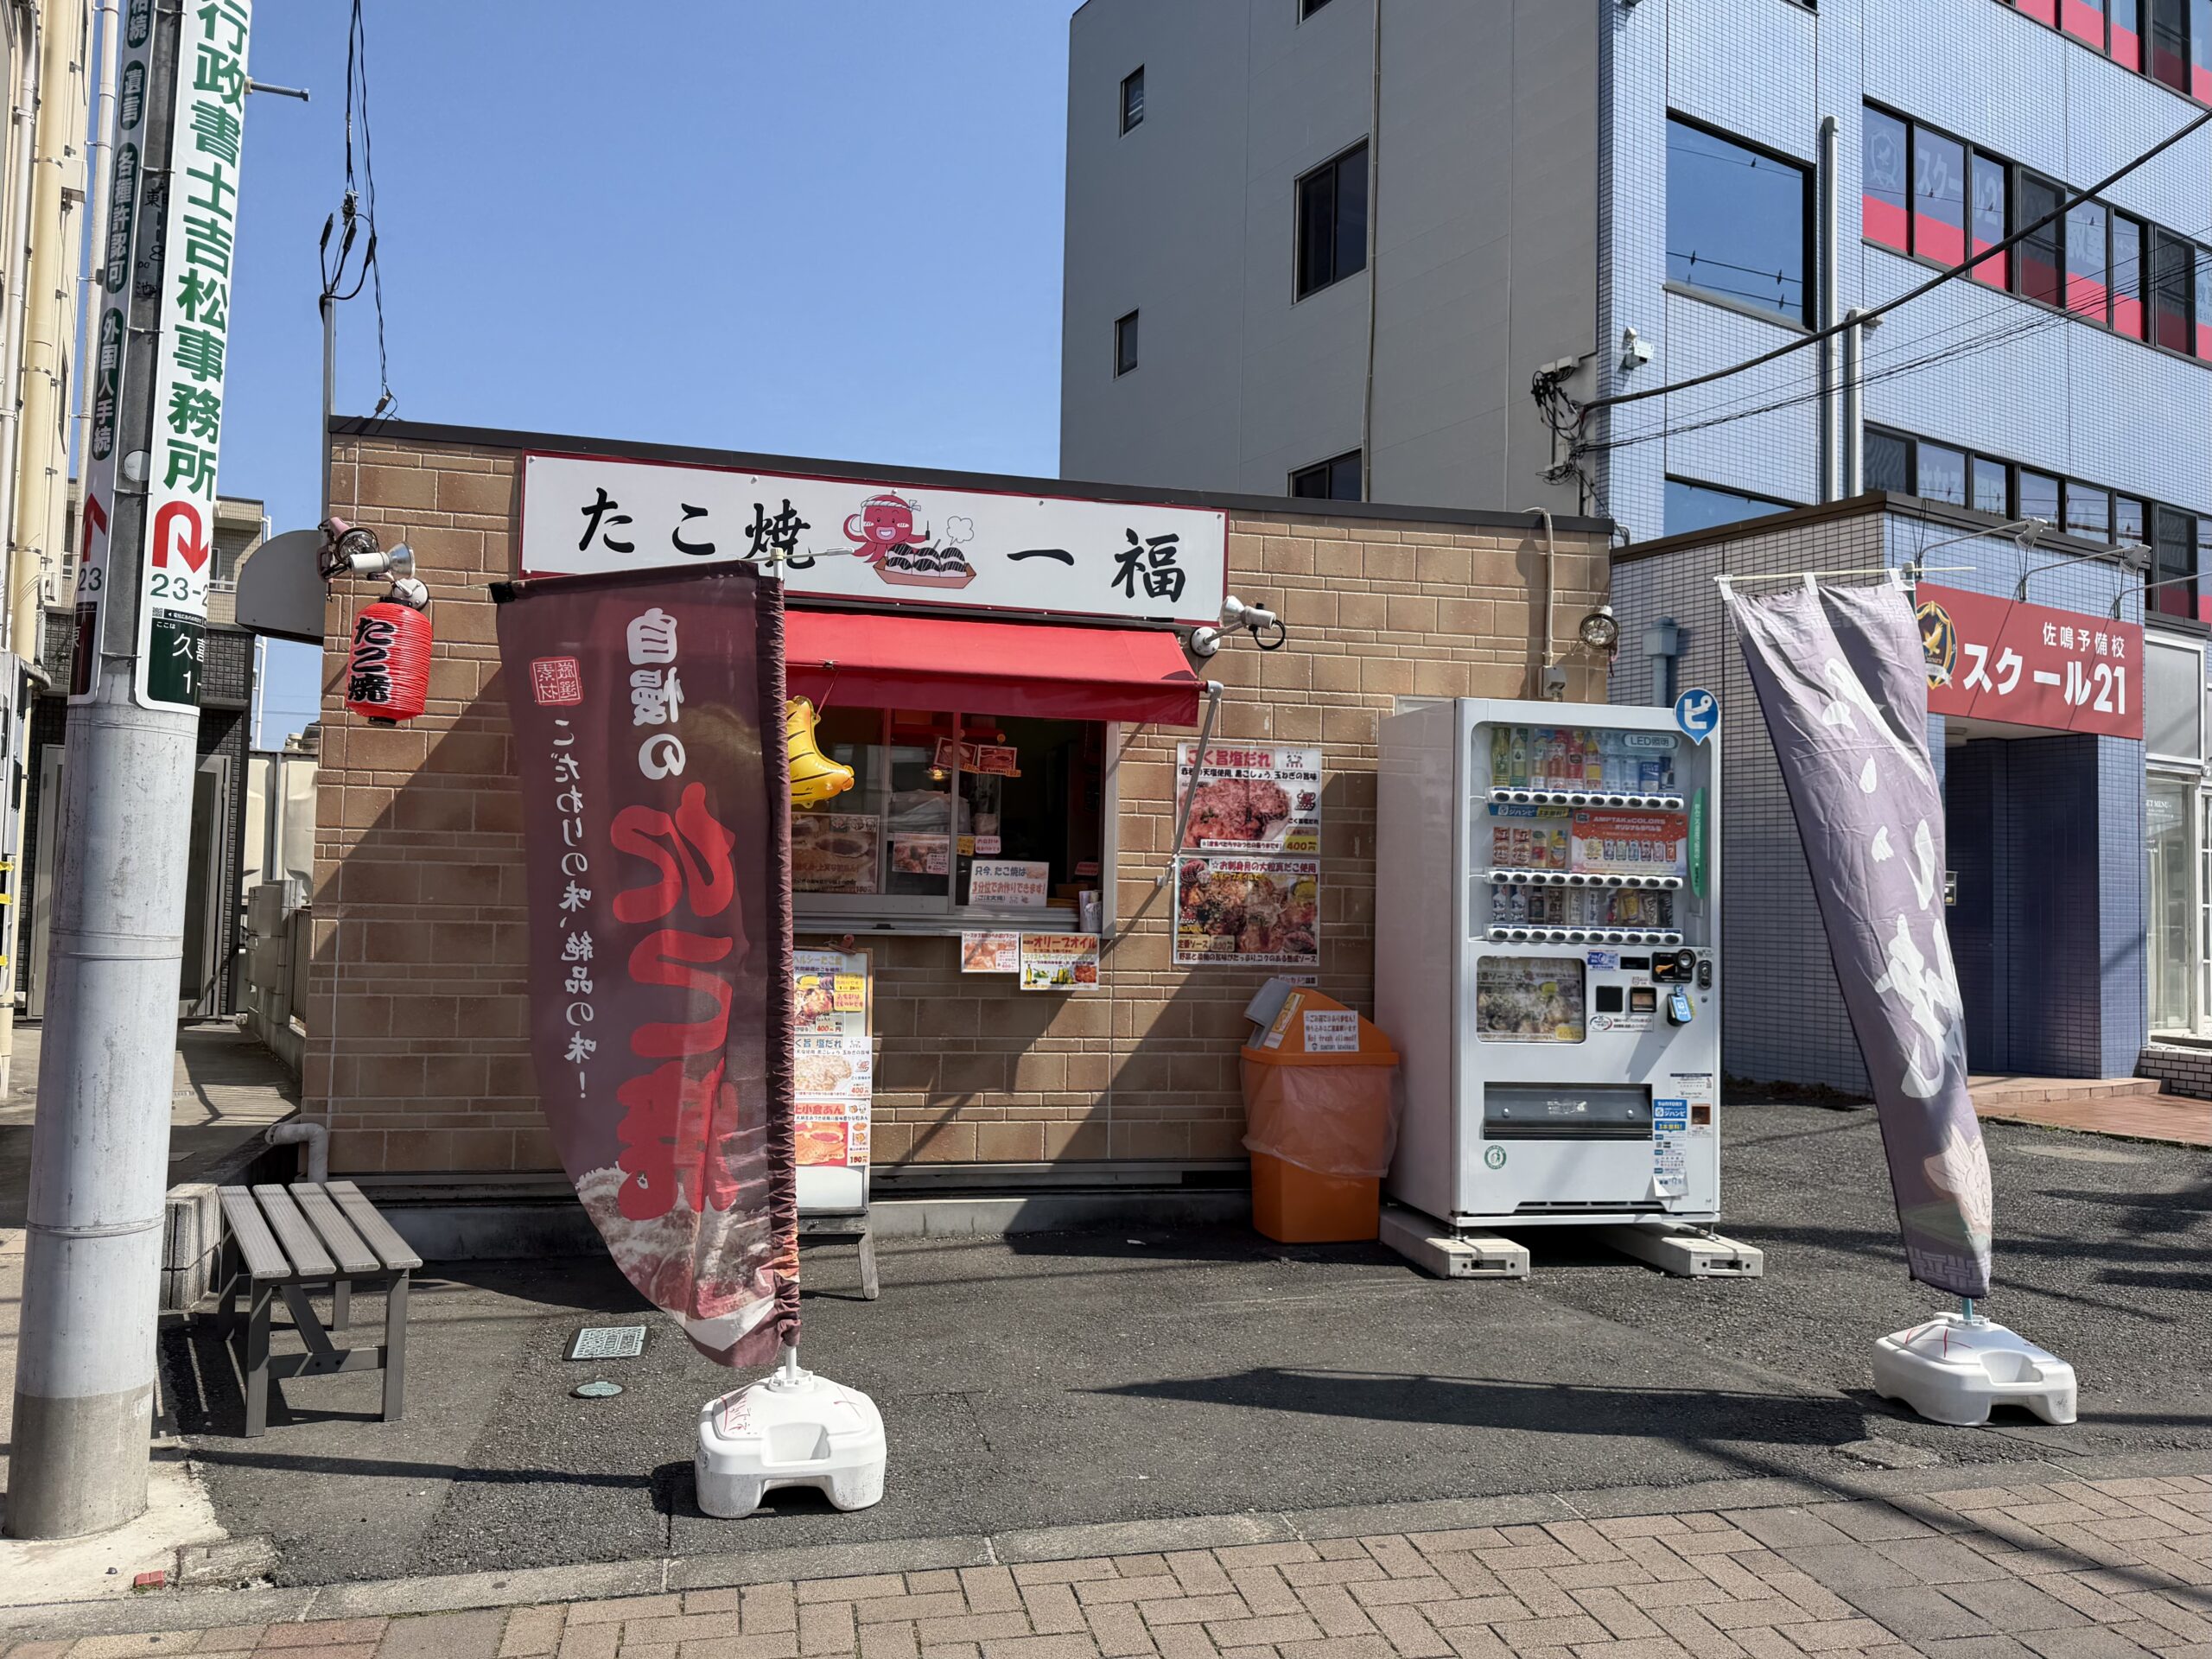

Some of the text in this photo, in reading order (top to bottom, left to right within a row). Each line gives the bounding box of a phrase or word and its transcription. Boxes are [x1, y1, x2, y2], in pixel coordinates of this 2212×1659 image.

[124, 68, 143, 122] 遺言
[108, 151, 137, 287] 各種許認可
[1918, 148, 2004, 226] スクール2
[163, 0, 249, 501] 行政書士吉松事務所
[94, 317, 122, 453] 外国人手続
[579, 487, 1187, 602] たこ焼 一福
[348, 617, 395, 703] たこ焼
[2043, 621, 2126, 659] 佐鳴予備校
[1684, 695, 1713, 730] ピ
[1962, 643, 2126, 715] スクール21
[1630, 735, 1669, 747] LED照明
[795, 1105, 843, 1115] 上小倉あん
